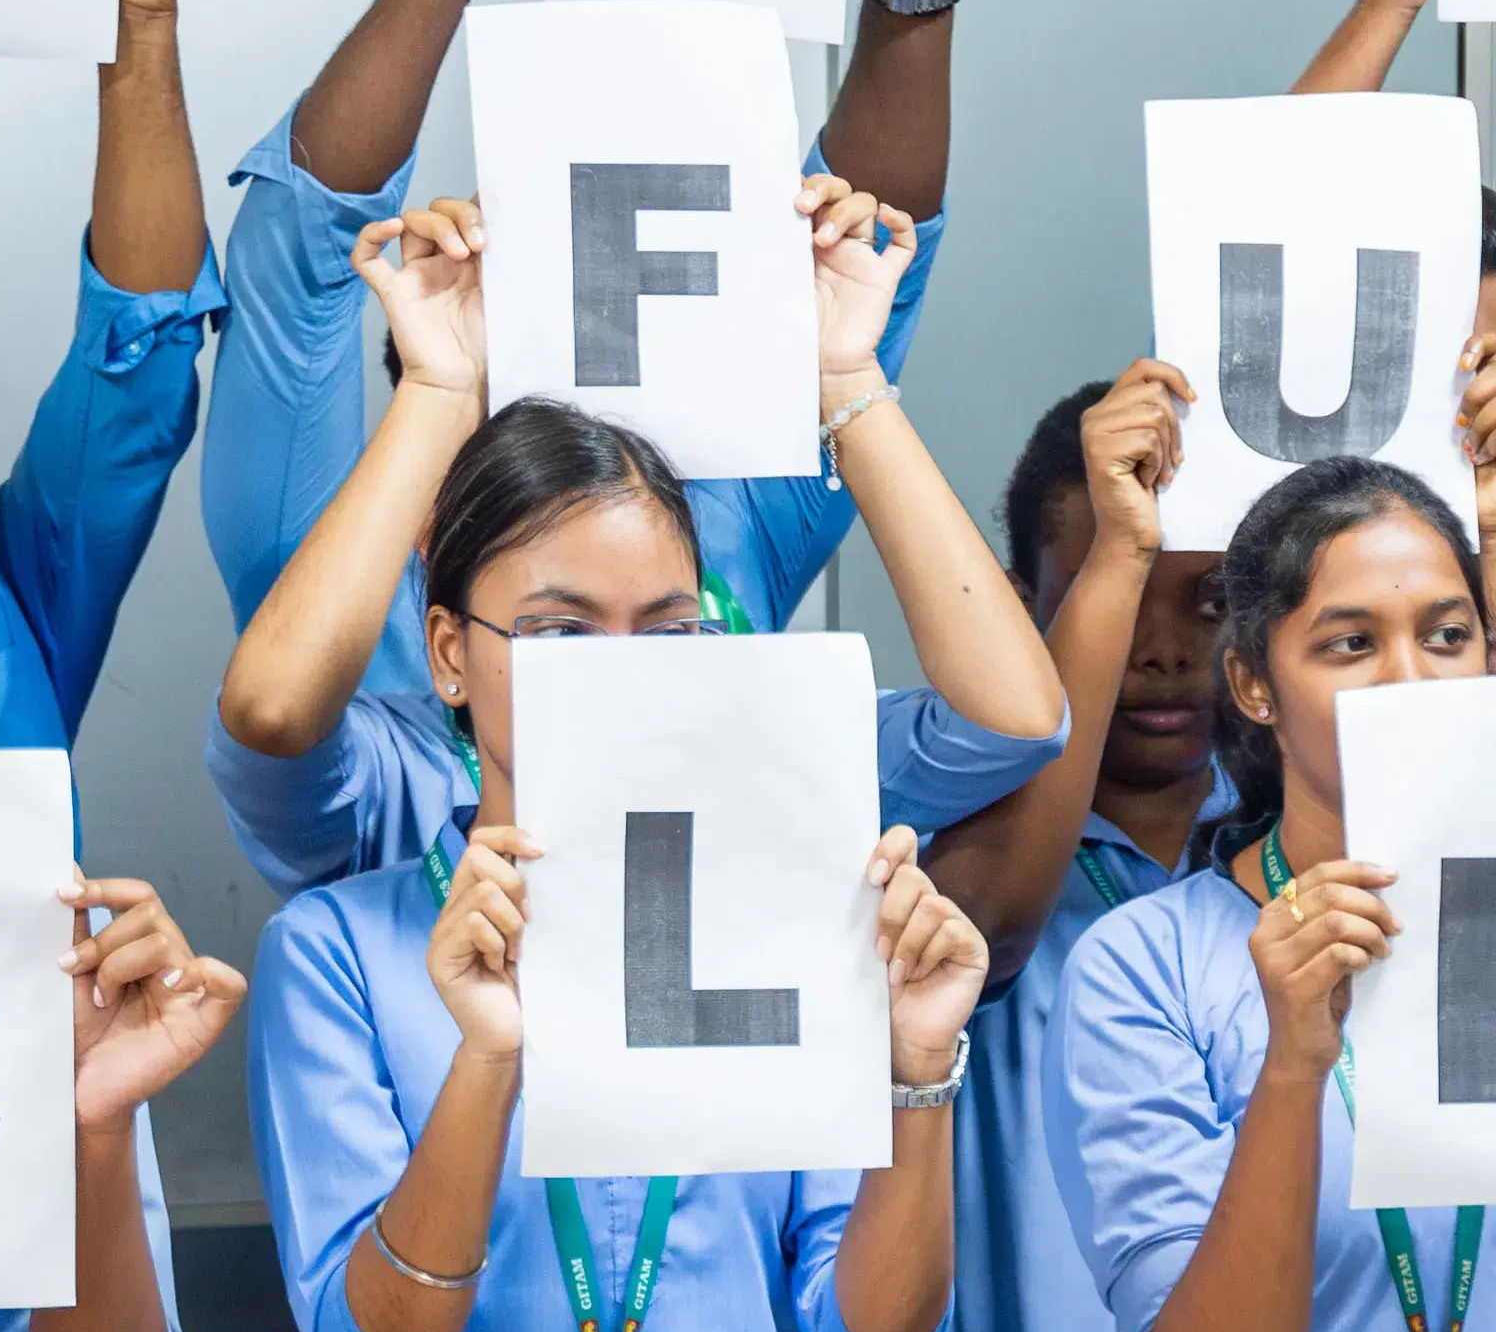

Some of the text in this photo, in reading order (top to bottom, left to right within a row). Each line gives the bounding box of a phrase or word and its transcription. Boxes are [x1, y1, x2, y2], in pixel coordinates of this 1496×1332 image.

[570, 163, 731, 388] F
[1219, 243, 1420, 466] U
[624, 812, 801, 1049] L
[570, 1257, 592, 1310] GITAM
[633, 1256, 654, 1311] GITAM
[1394, 1253, 1418, 1306] GITAM
[1457, 1258, 1473, 1312] GITAM
